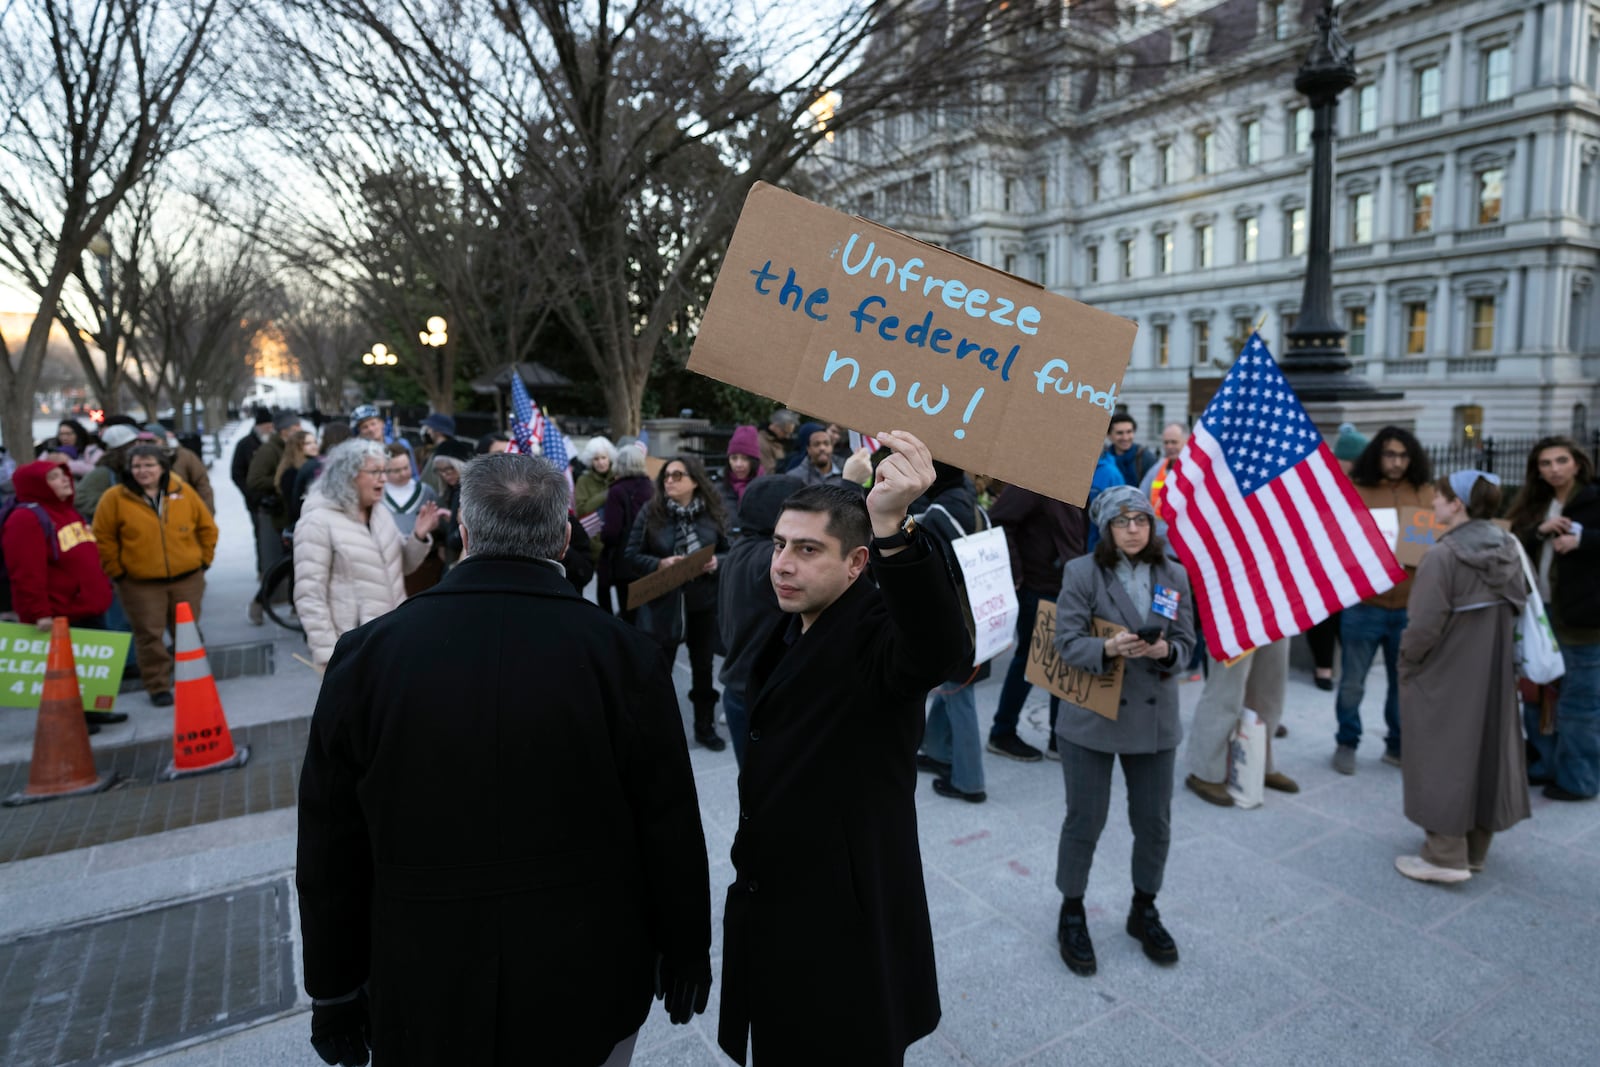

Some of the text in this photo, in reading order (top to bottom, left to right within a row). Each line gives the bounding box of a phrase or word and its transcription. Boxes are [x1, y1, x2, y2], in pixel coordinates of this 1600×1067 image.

[751, 261, 829, 321] the
[851, 295, 1021, 382] federal
[841, 233, 1042, 335] Unfreeze
[822, 350, 985, 440] now!
[9, 679, 25, 695] 4
[12, 638, 114, 659] DEAND
